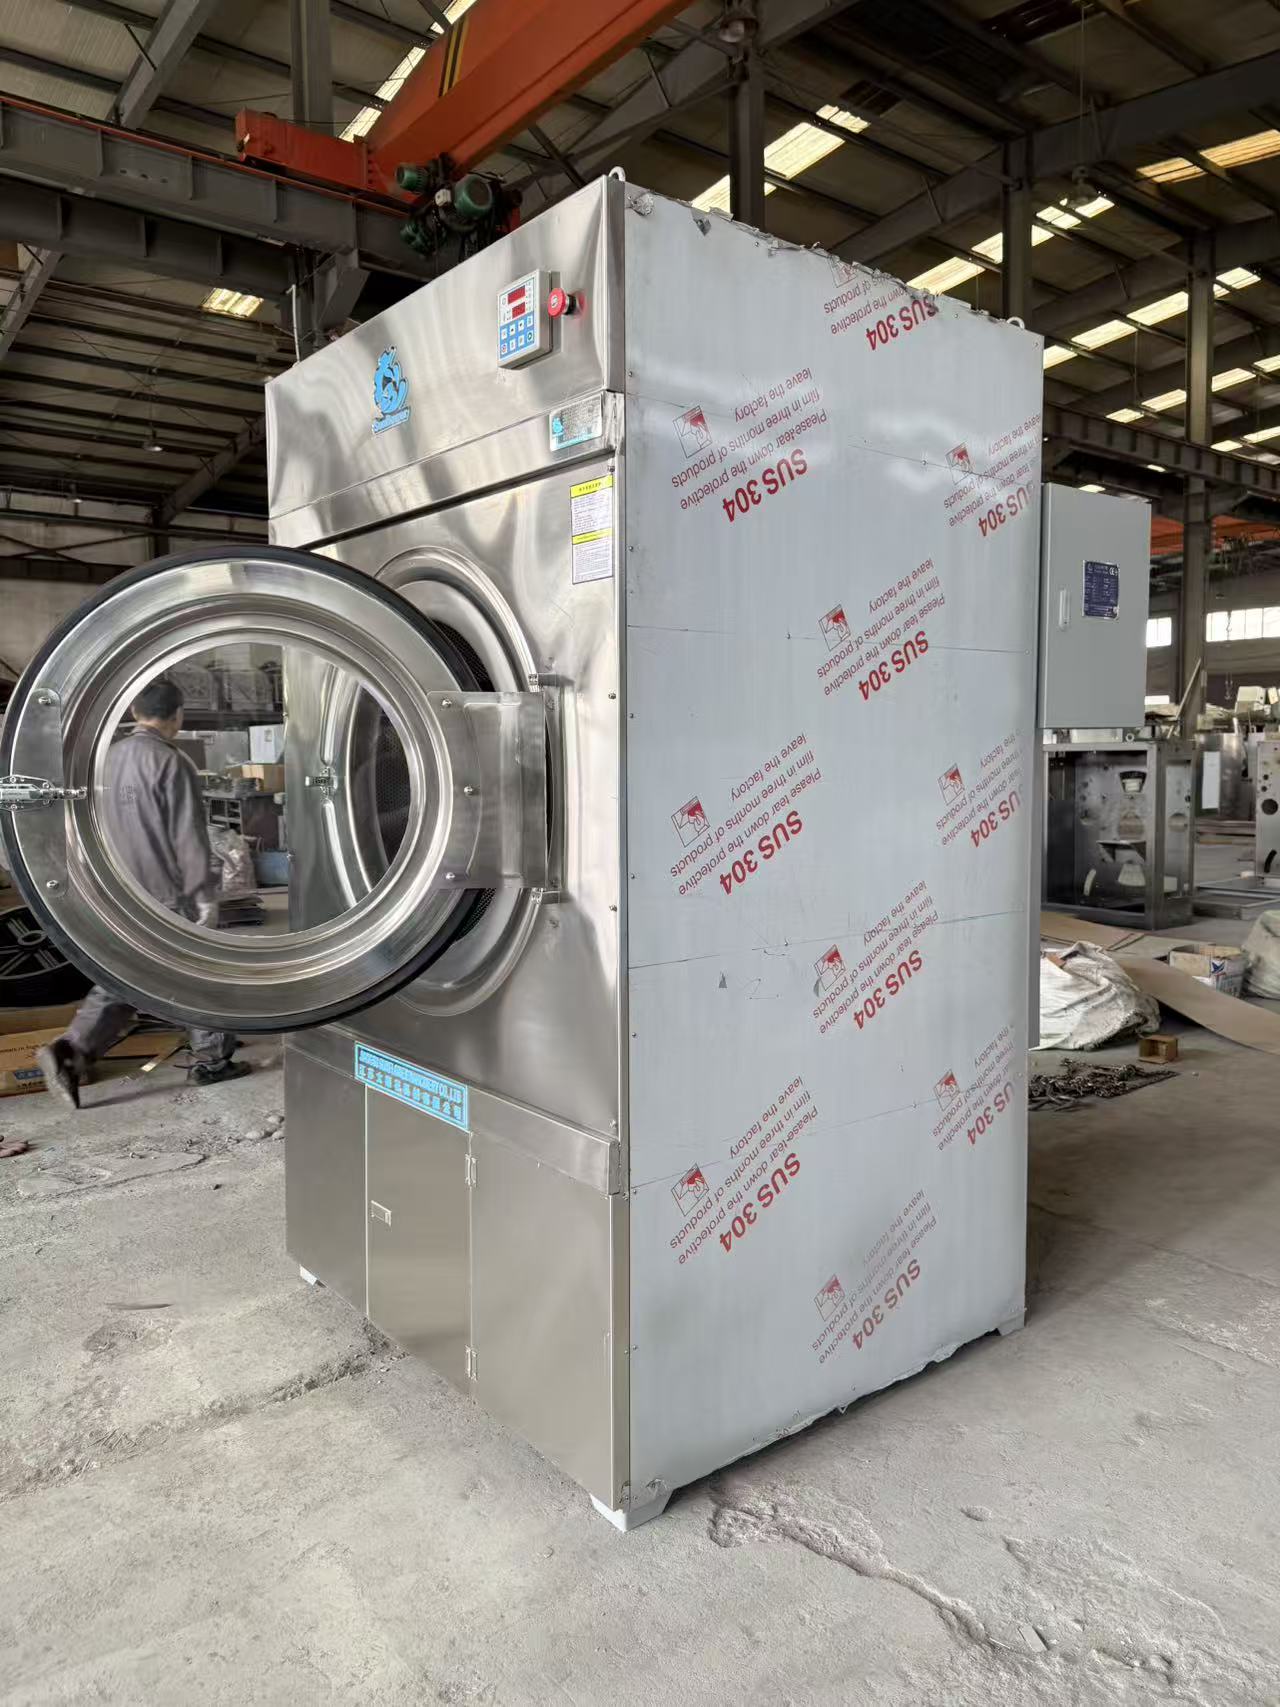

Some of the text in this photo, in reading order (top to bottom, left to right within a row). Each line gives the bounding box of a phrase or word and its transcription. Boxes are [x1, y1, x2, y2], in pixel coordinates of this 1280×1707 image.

[824, 283, 861, 314] products
[831, 308, 872, 334] protective
[866, 314, 899, 350] 304
[873, 300, 886, 309] the
[735, 368, 812, 422] leave the factory
[671, 388, 820, 488] film in three months of products
[730, 464, 748, 477] the
[750, 442, 774, 465] down
[680, 472, 730, 510] protective
[723, 448, 808, 522] SUS 304
[979, 504, 1006, 537] 304
[869, 558, 934, 614] leave the factory
[817, 576, 940, 679] film in three months of products
[824, 593, 945, 695] Please tear down the protective
[858, 630, 929, 701] SUS 304
[730, 733, 807, 802] leave the factory
[670, 750, 815, 877] film in three months of products
[679, 768, 822, 895] Please tear down the protective
[971, 811, 998, 847] 304
[719, 810, 803, 895] SUS 304
[864, 880, 926, 947] leave the factory
[813, 896, 933, 1018] film in three months of products
[819, 911, 938, 1034] Please tear down the protective
[854, 950, 922, 1029] SUS 304
[730, 1076, 803, 1159] leave the factory
[968, 1106, 994, 1145] 304
[670, 1090, 811, 1249] film in three months of products
[678, 1106, 818, 1264] Please tear down the protective
[720, 1152, 801, 1252] SUS 304
[852, 1258, 920, 1350] SUS 304
